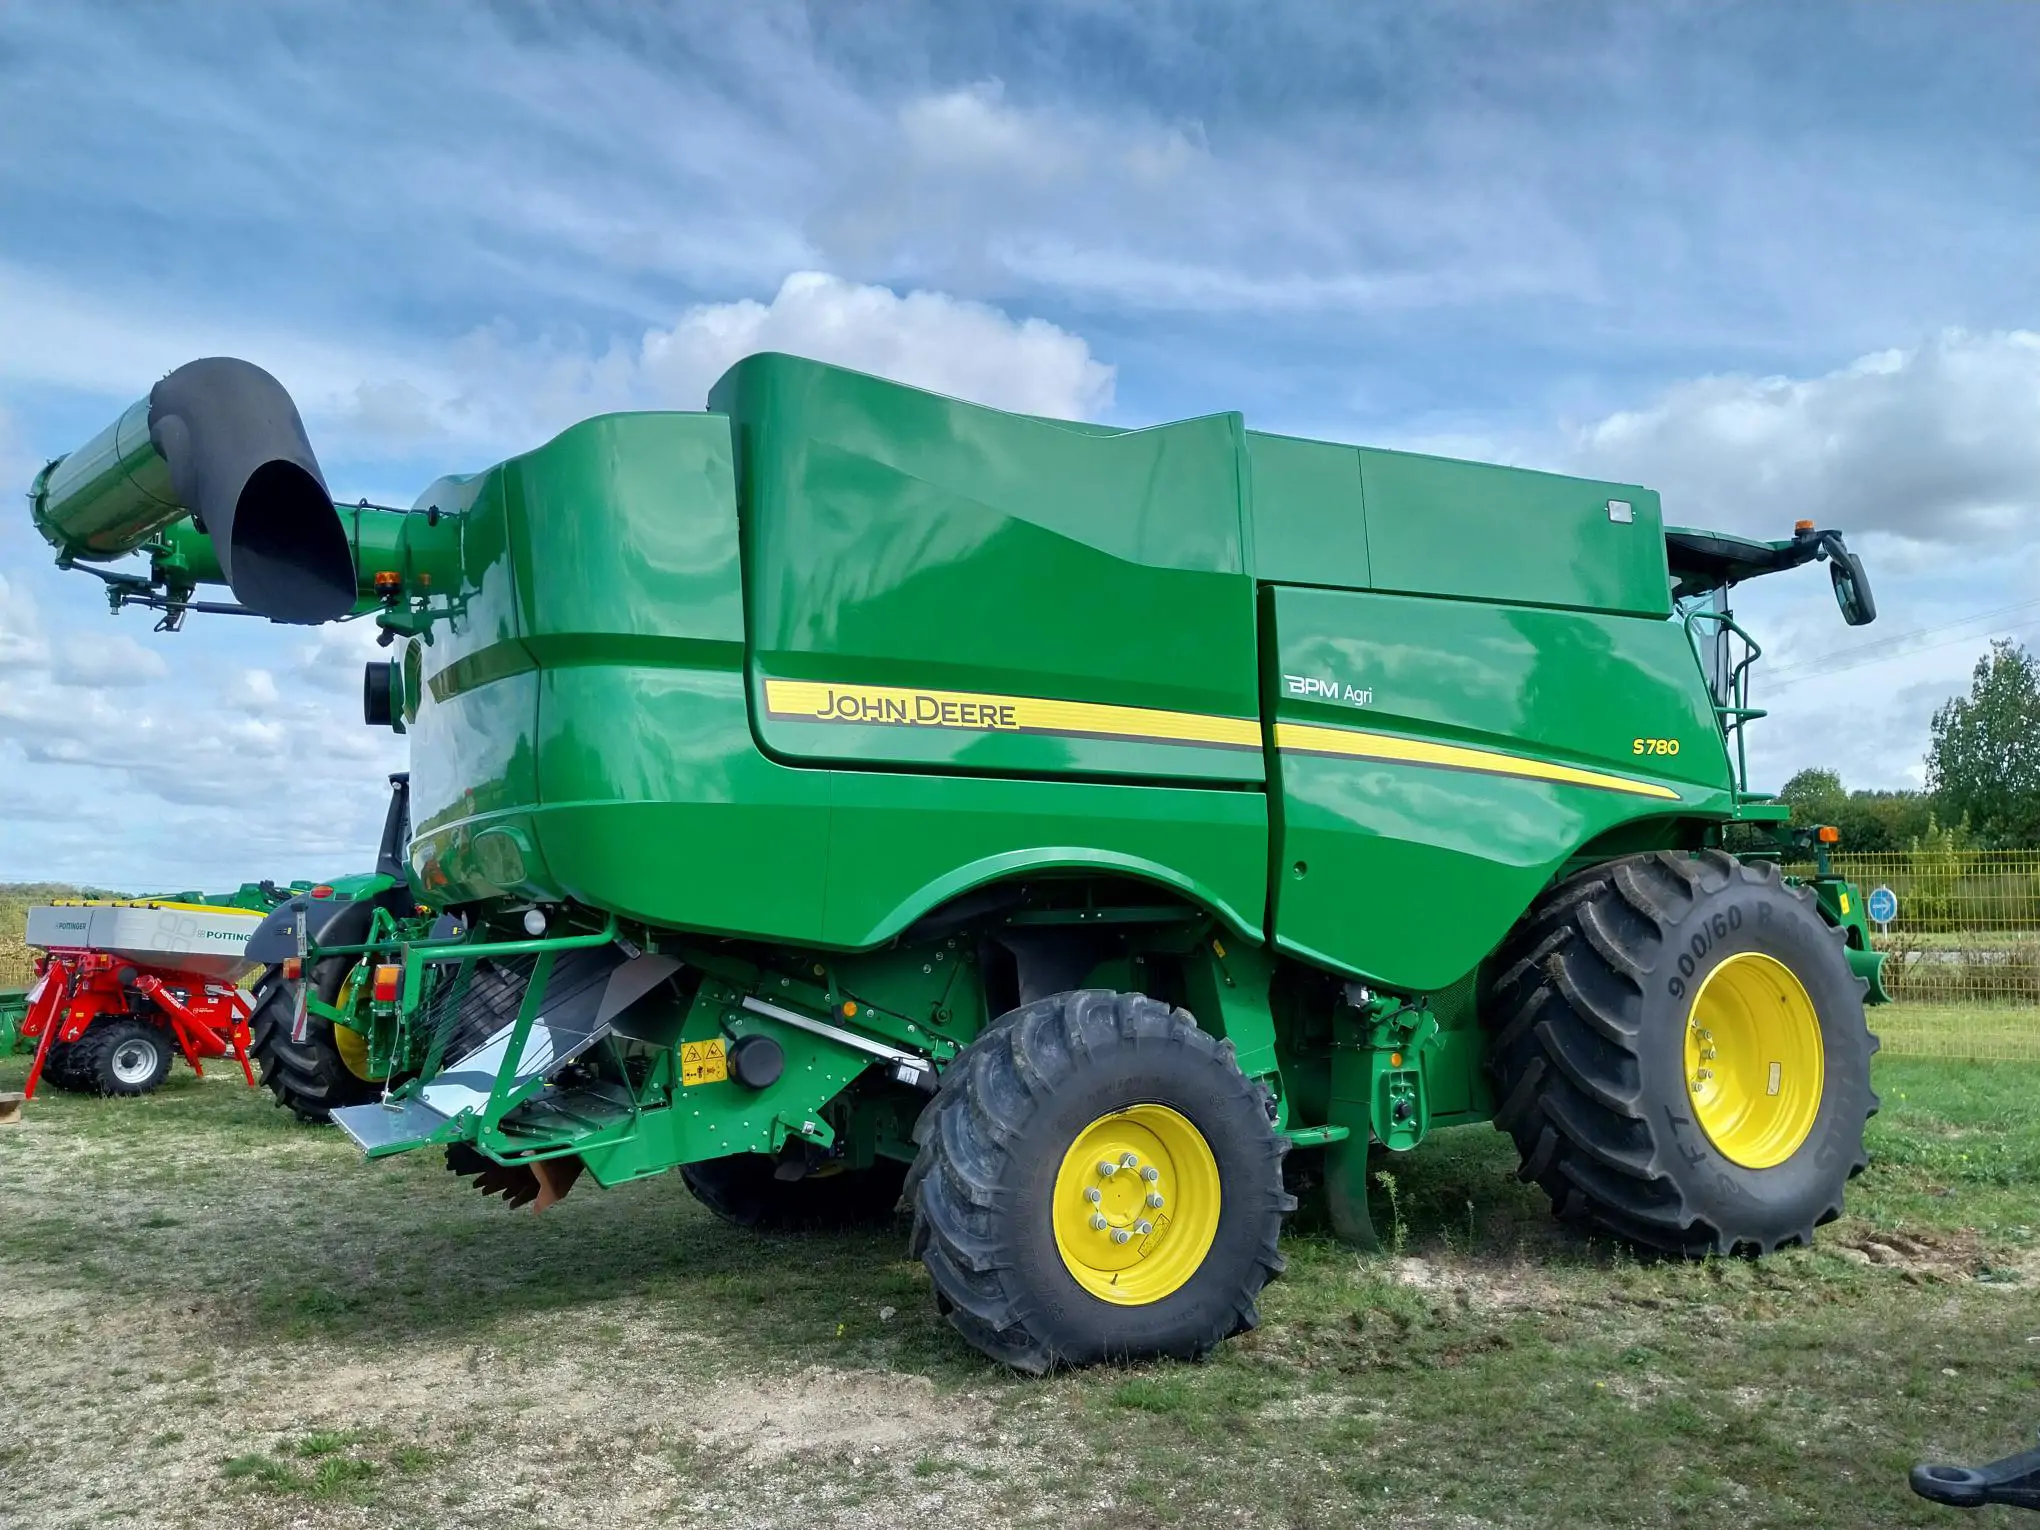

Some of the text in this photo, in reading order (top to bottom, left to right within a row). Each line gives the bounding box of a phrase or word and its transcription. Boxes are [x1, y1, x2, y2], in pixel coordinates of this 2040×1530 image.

[1283, 674, 1373, 706] BPM Agri
[816, 690, 1018, 726] JOHN DEERE
[1632, 738, 1680, 756] S780
[1667, 904, 1742, 1001] 900/60
